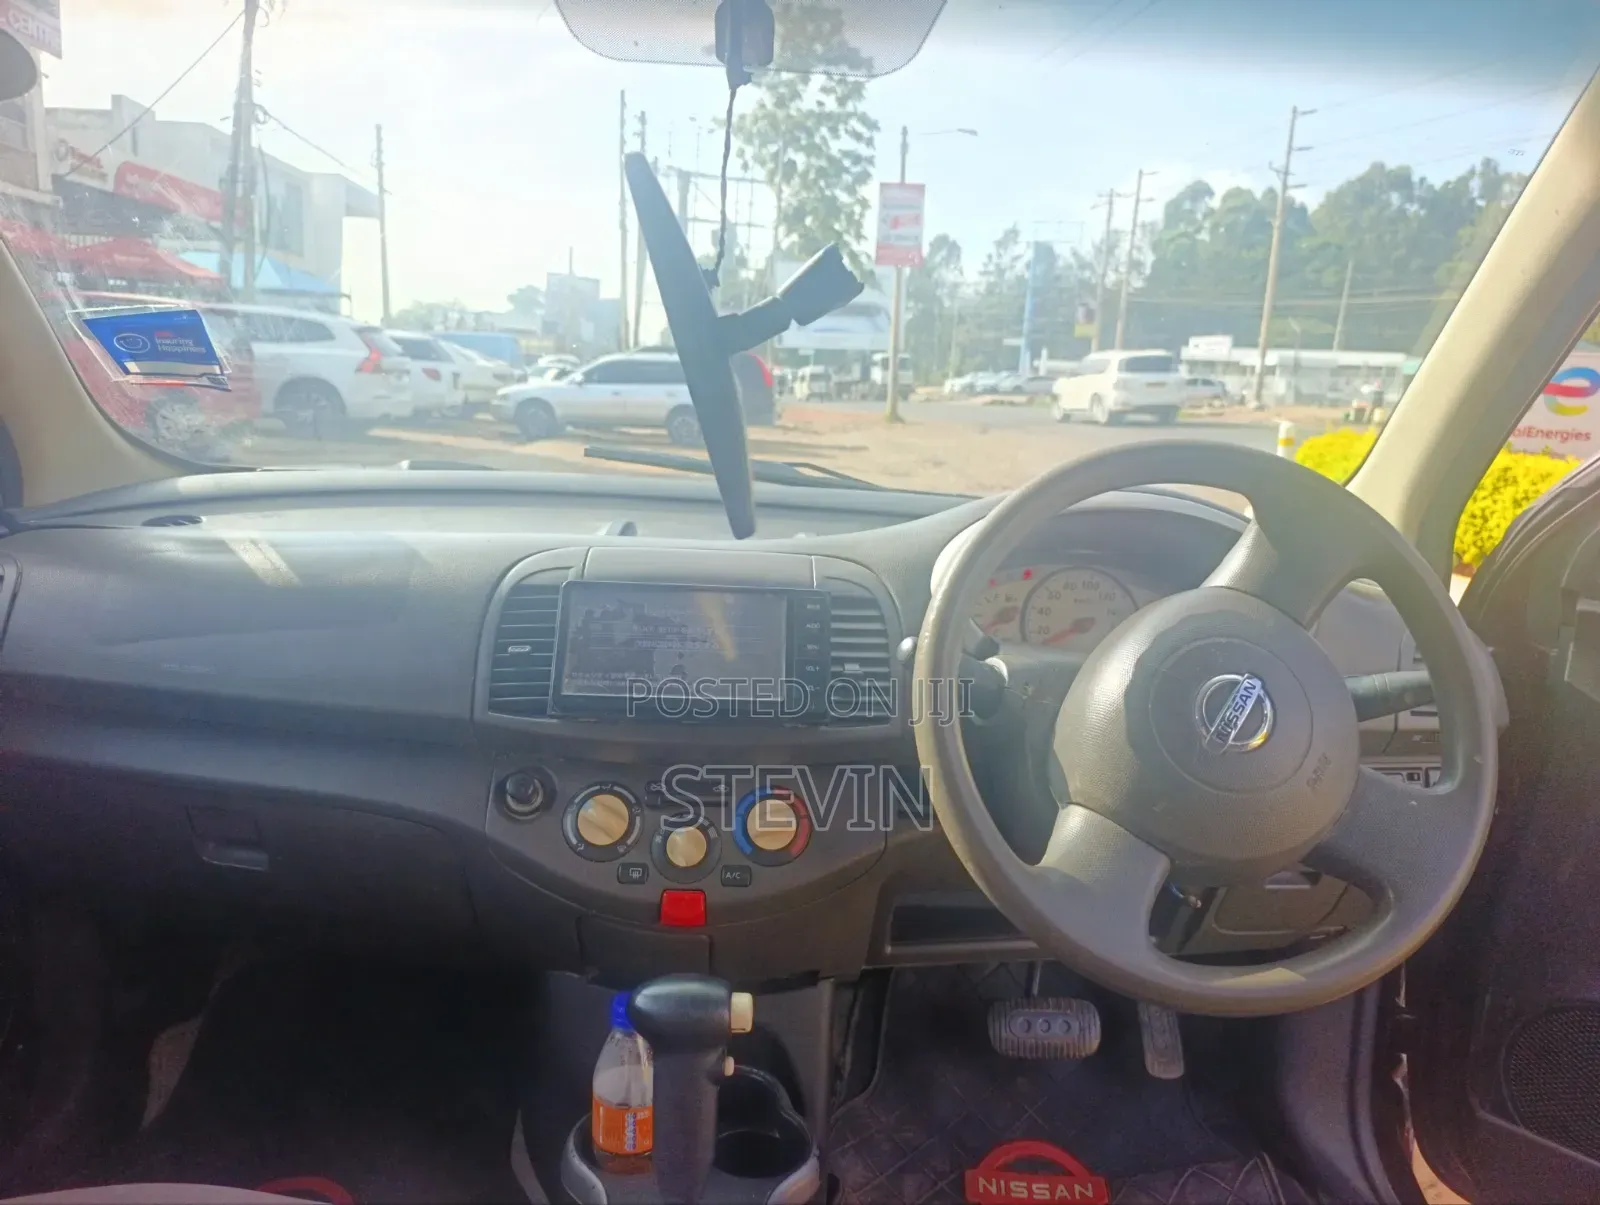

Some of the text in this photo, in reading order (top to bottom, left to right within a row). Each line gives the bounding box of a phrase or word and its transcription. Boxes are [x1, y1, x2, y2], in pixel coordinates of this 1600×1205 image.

[1511, 425, 1592, 443] alEnergies
[1215, 681, 1257, 744] NISSAN
[725, 871, 741, 880] A/C
[978, 1176, 1094, 1200] NISSAN
